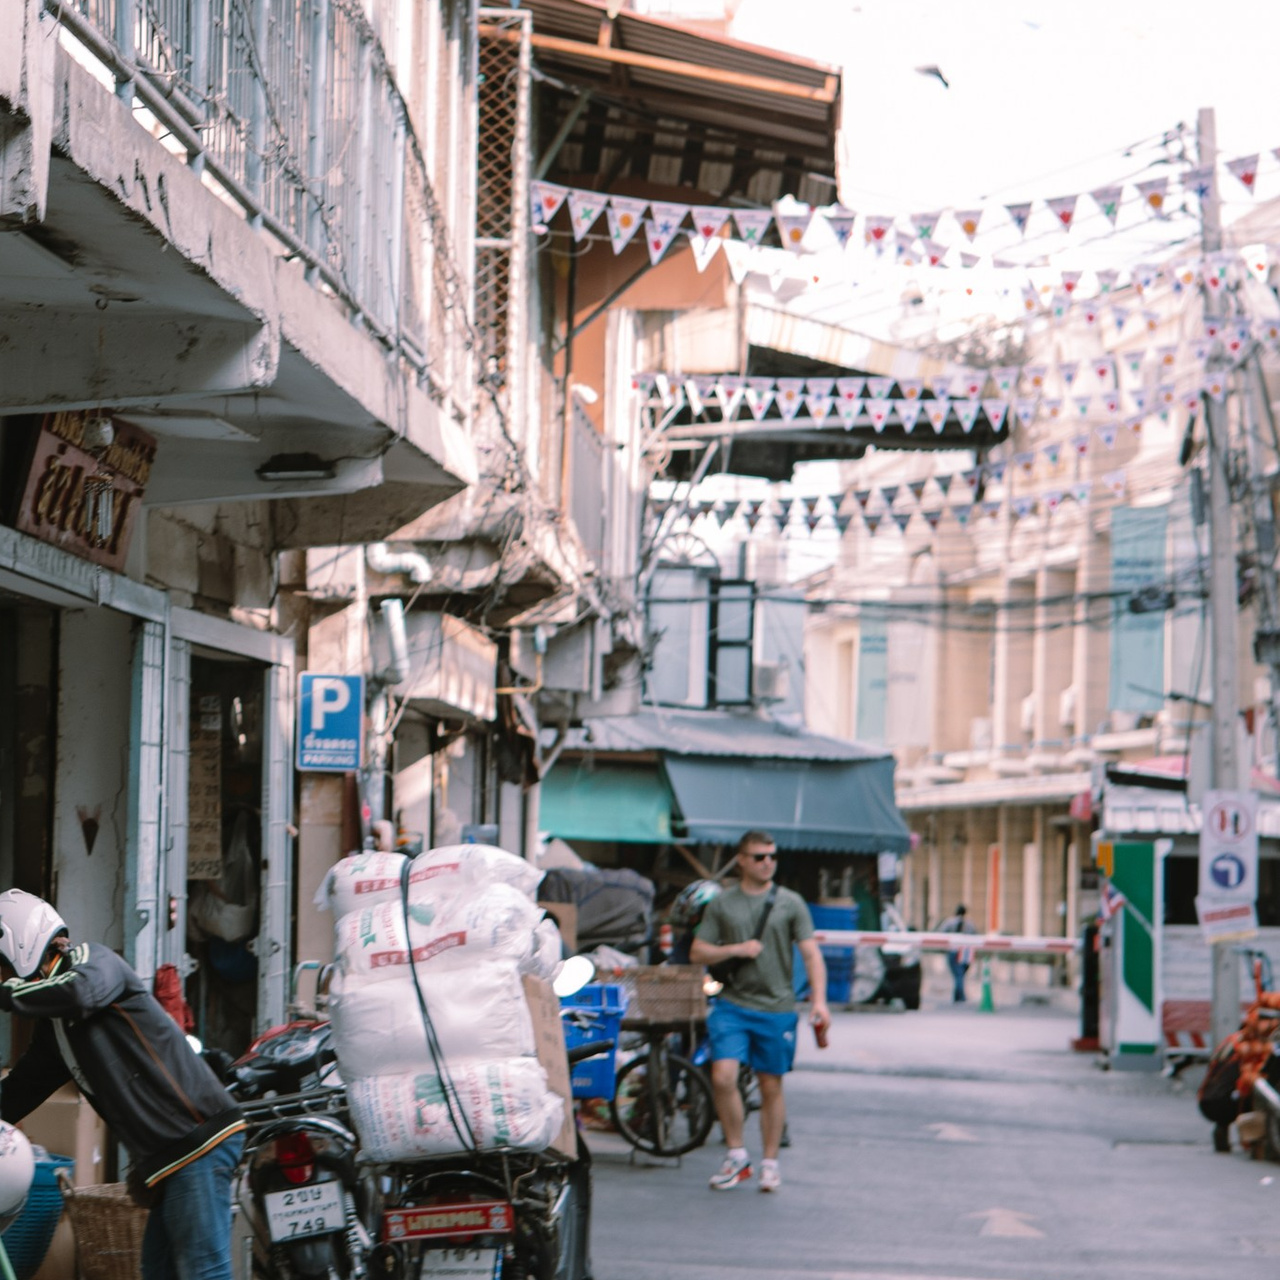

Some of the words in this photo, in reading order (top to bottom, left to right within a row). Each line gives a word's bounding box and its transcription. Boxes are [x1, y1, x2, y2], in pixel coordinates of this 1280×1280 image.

[311, 677, 351, 731] P
[303, 754, 357, 766] PARKING
[287, 1216, 326, 1237] 749
[406, 1210, 487, 1231] LIVERPOOL
